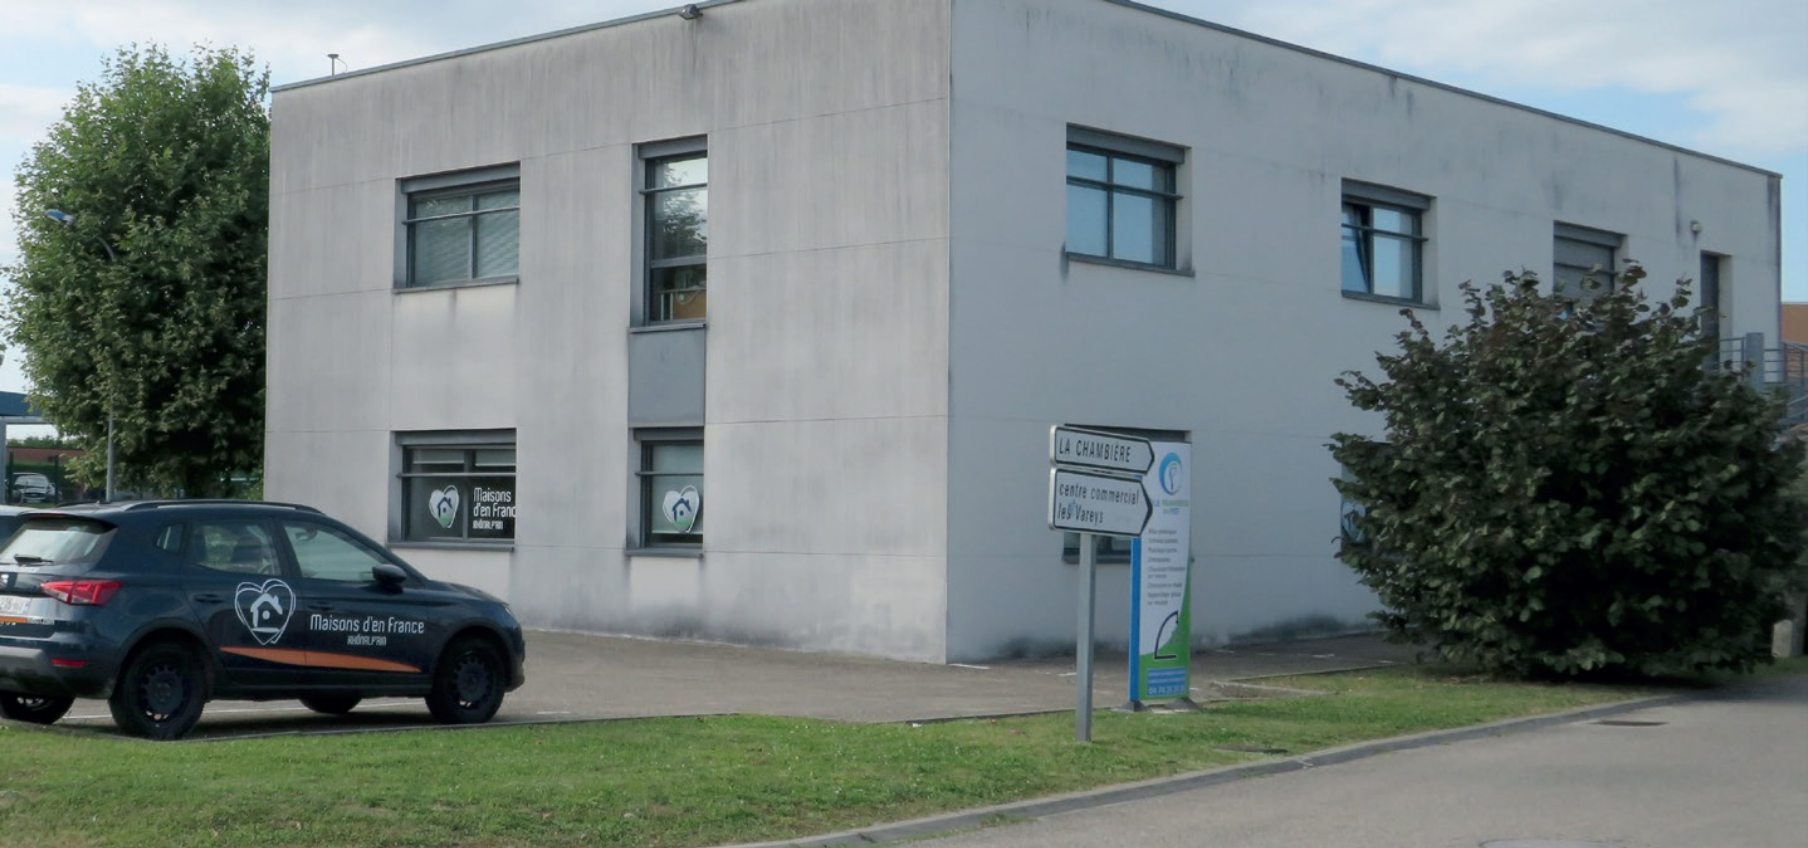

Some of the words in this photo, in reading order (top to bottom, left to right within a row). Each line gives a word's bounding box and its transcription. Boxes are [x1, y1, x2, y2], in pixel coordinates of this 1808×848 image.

[1059, 438, 1071, 455] LA
[1076, 440, 1131, 463] CHAMBIÈRE
[473, 487, 512, 503] Maisons
[1060, 483, 1087, 499] centre
[1091, 487, 1140, 505] commercial
[473, 502, 491, 517] d'en
[492, 502, 516, 518] Franc
[1058, 502, 1071, 520] les
[1075, 504, 1104, 526] Vareys
[310, 614, 360, 631] Maisons
[362, 615, 385, 633] d'en
[388, 616, 425, 634] France
